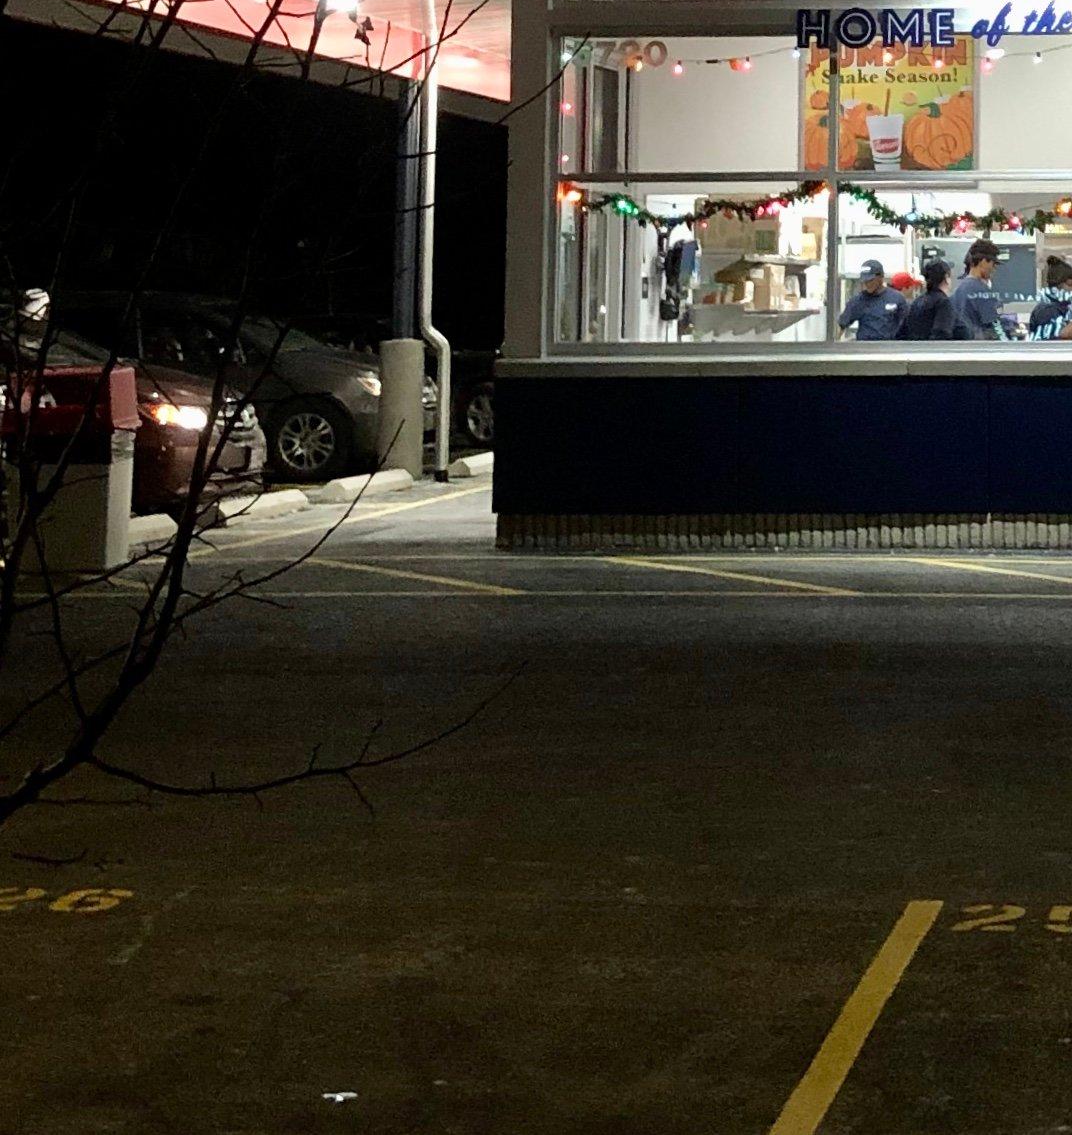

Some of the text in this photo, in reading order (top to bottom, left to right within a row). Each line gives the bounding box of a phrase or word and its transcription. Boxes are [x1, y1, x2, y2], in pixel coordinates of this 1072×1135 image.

[797, 7, 955, 49] HOME
[971, 1, 1012, 47] of
[884, 67, 958, 83] Season!
[0, 887, 135, 913] 26
